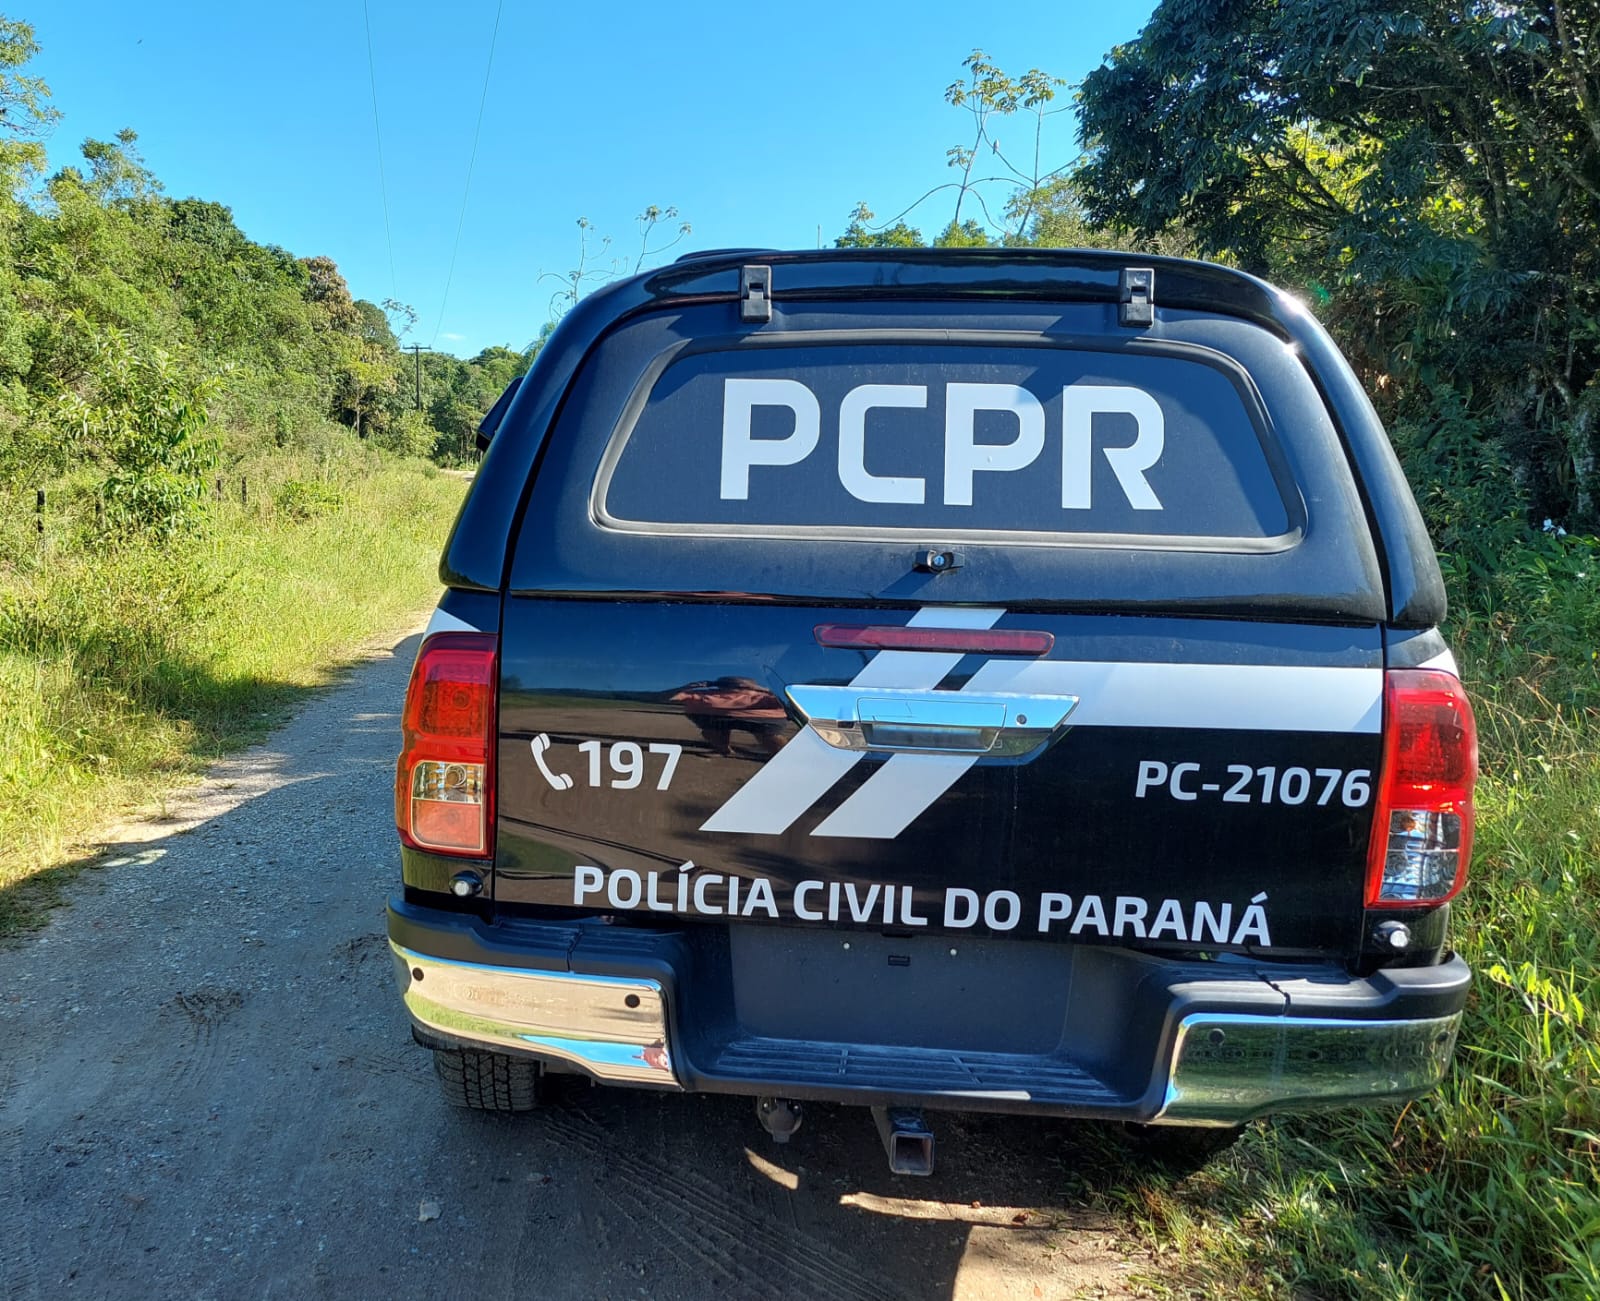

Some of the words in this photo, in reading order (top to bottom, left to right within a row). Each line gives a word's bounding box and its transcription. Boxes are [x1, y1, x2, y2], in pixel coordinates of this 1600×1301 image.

[719, 378, 1165, 511] PCPR
[578, 740, 683, 791] 197
[1135, 760, 1371, 807] PC-21076
[573, 860, 779, 918] POLÍCIA
[793, 880, 928, 927] CIVIL
[943, 887, 1021, 932] DO
[1038, 891, 1271, 947] PARANÁ
